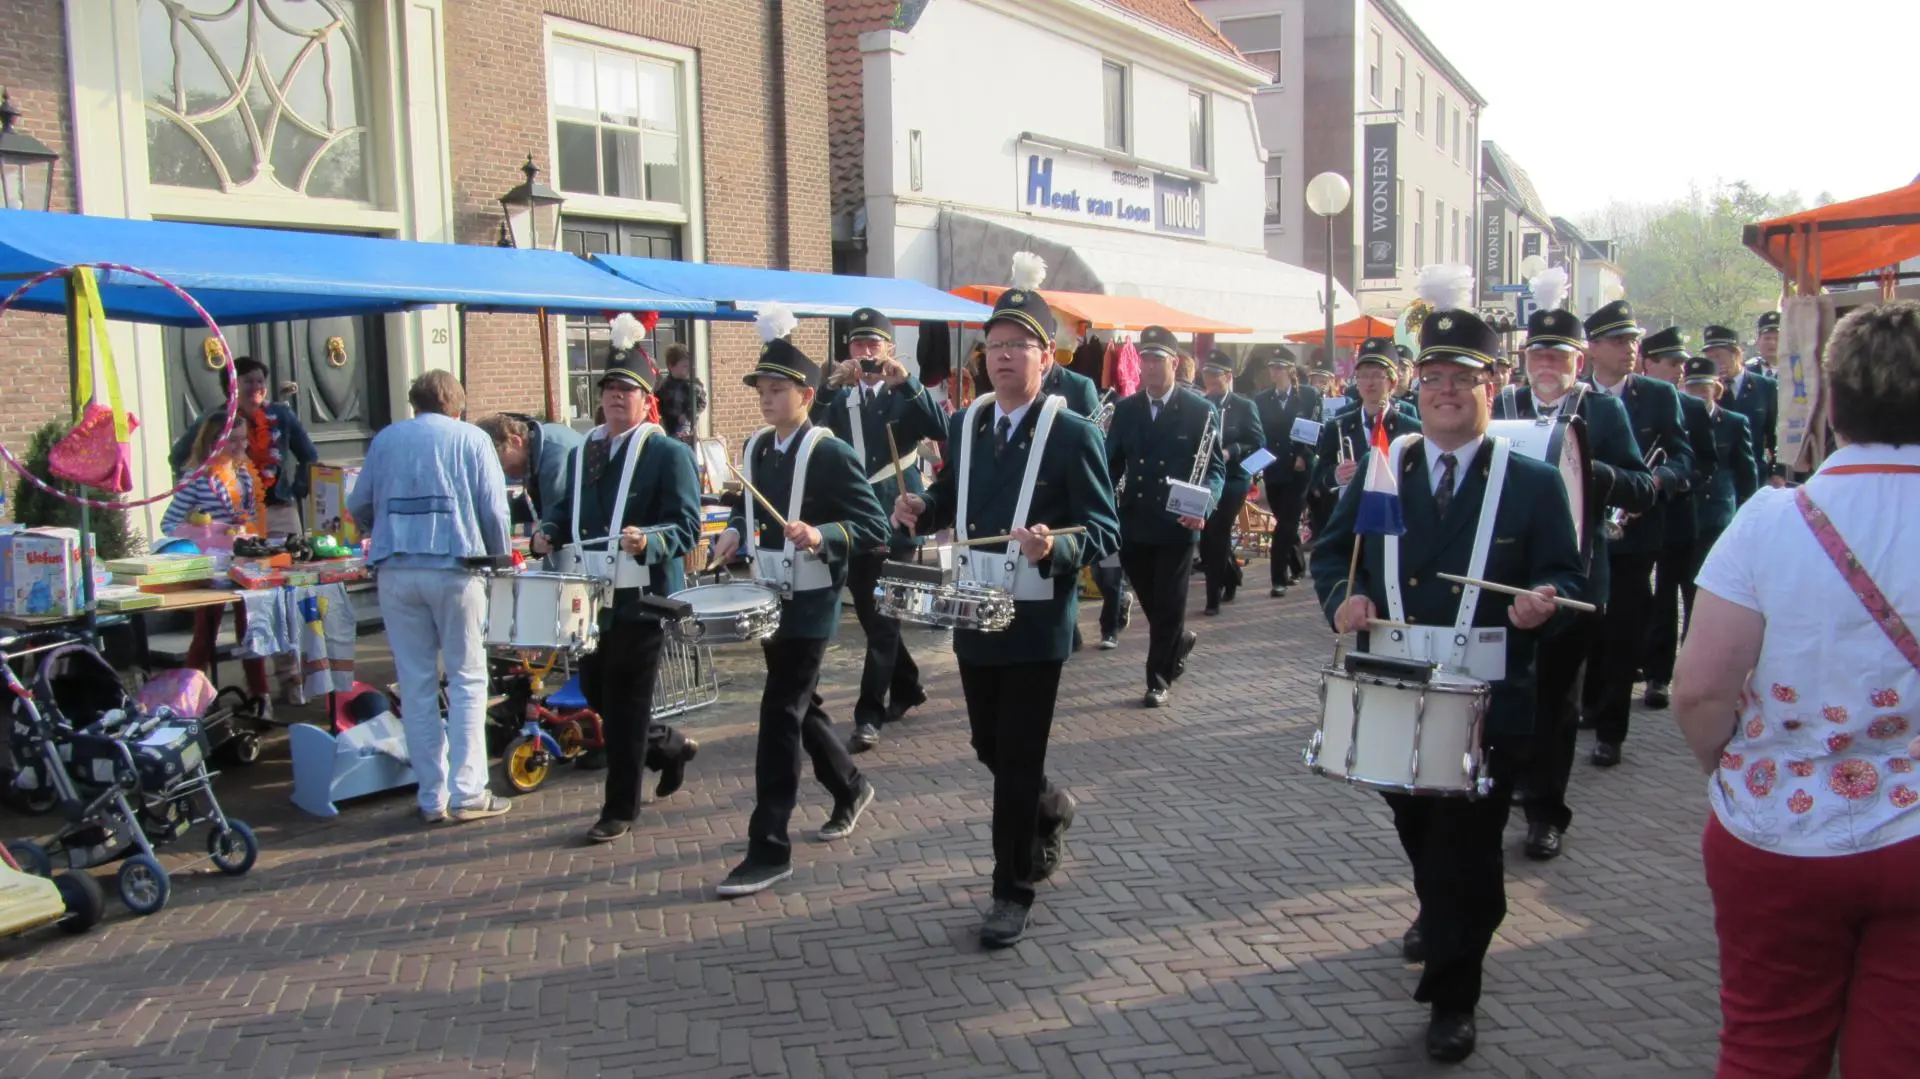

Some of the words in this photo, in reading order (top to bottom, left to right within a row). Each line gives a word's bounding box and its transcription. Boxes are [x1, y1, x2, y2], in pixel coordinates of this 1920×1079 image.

[1026, 154, 1080, 213] Henk
[1087, 197, 1113, 217] van
[1117, 198, 1151, 223] Loon
[1163, 187, 1201, 230] mode
[1373, 147, 1388, 233] WONEN
[1488, 215, 1499, 271] WONEN
[432, 328, 448, 344] 26
